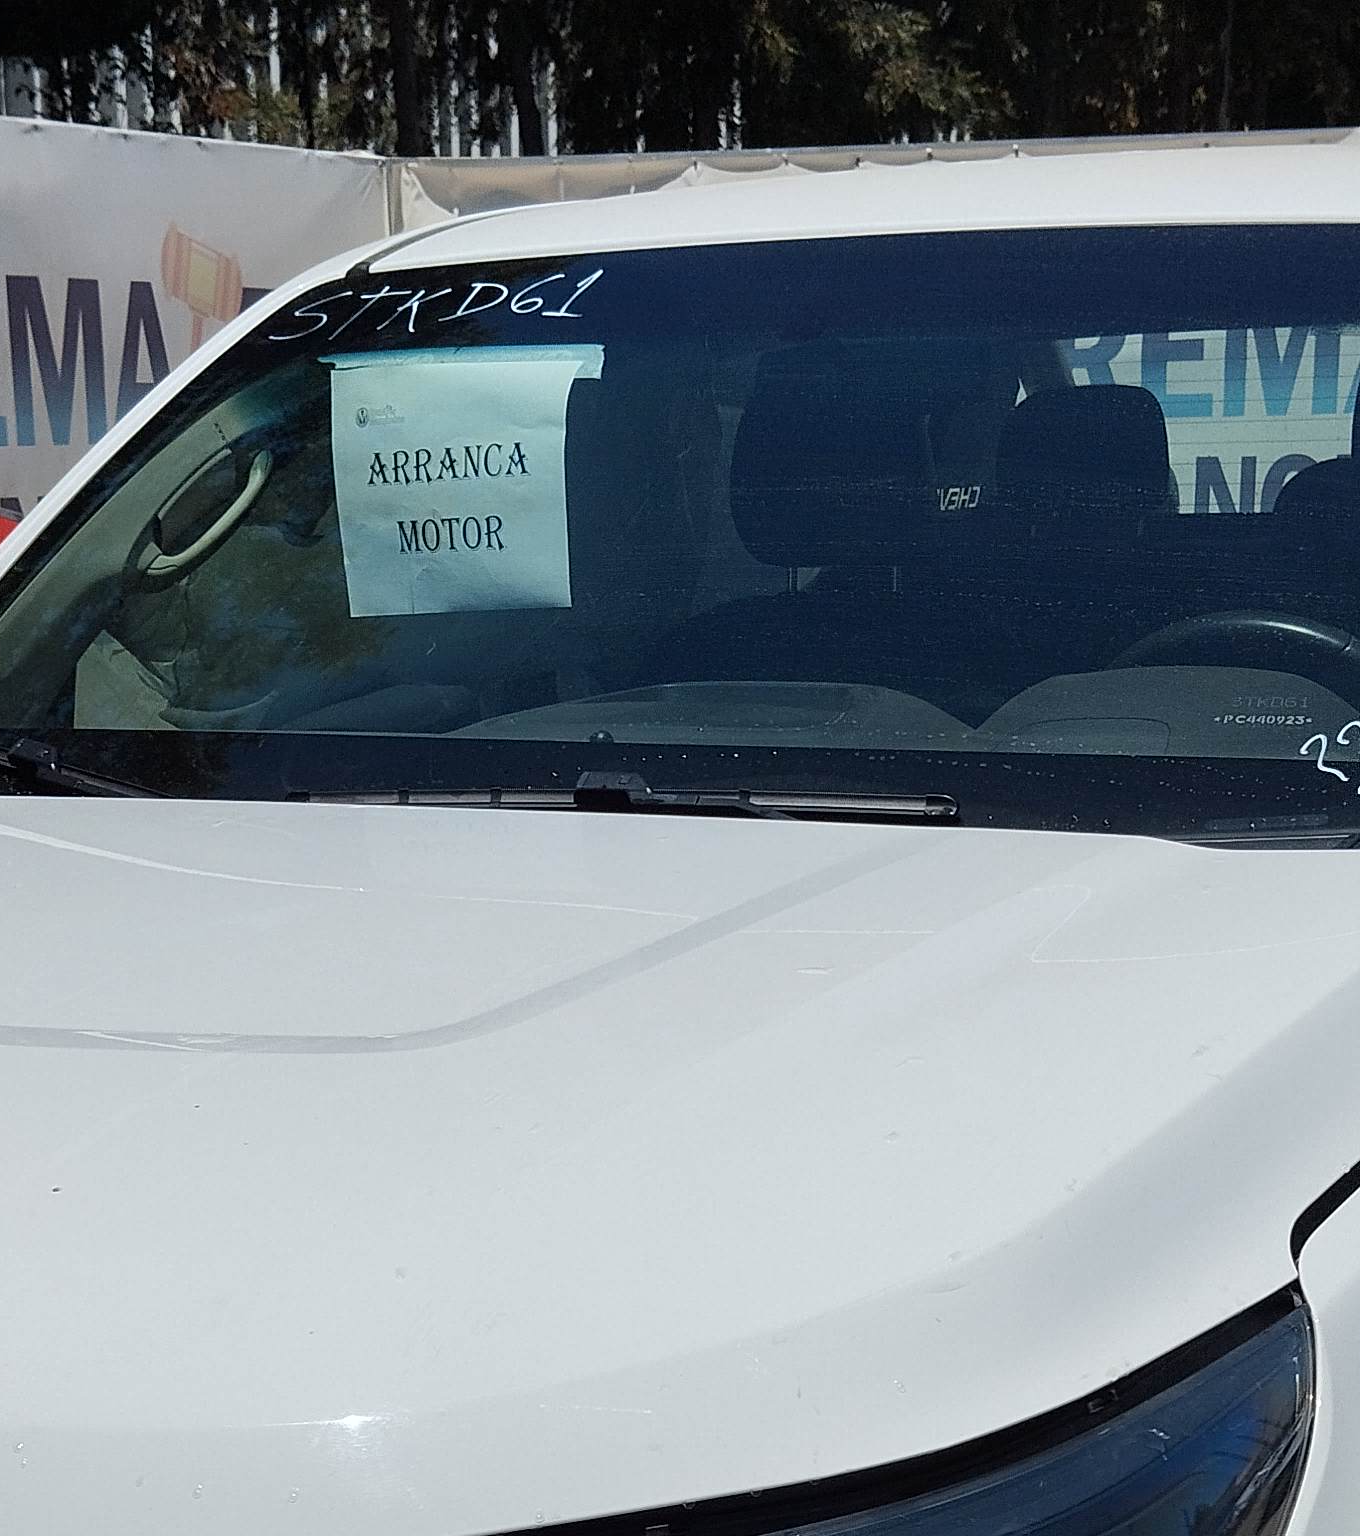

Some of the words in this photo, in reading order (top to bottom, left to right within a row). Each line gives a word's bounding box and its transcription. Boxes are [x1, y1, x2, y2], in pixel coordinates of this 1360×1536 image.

[268, 268, 604, 341] STKD61
[366, 440, 531, 488] ARRANCA
[397, 514, 505, 555] MOTOR
